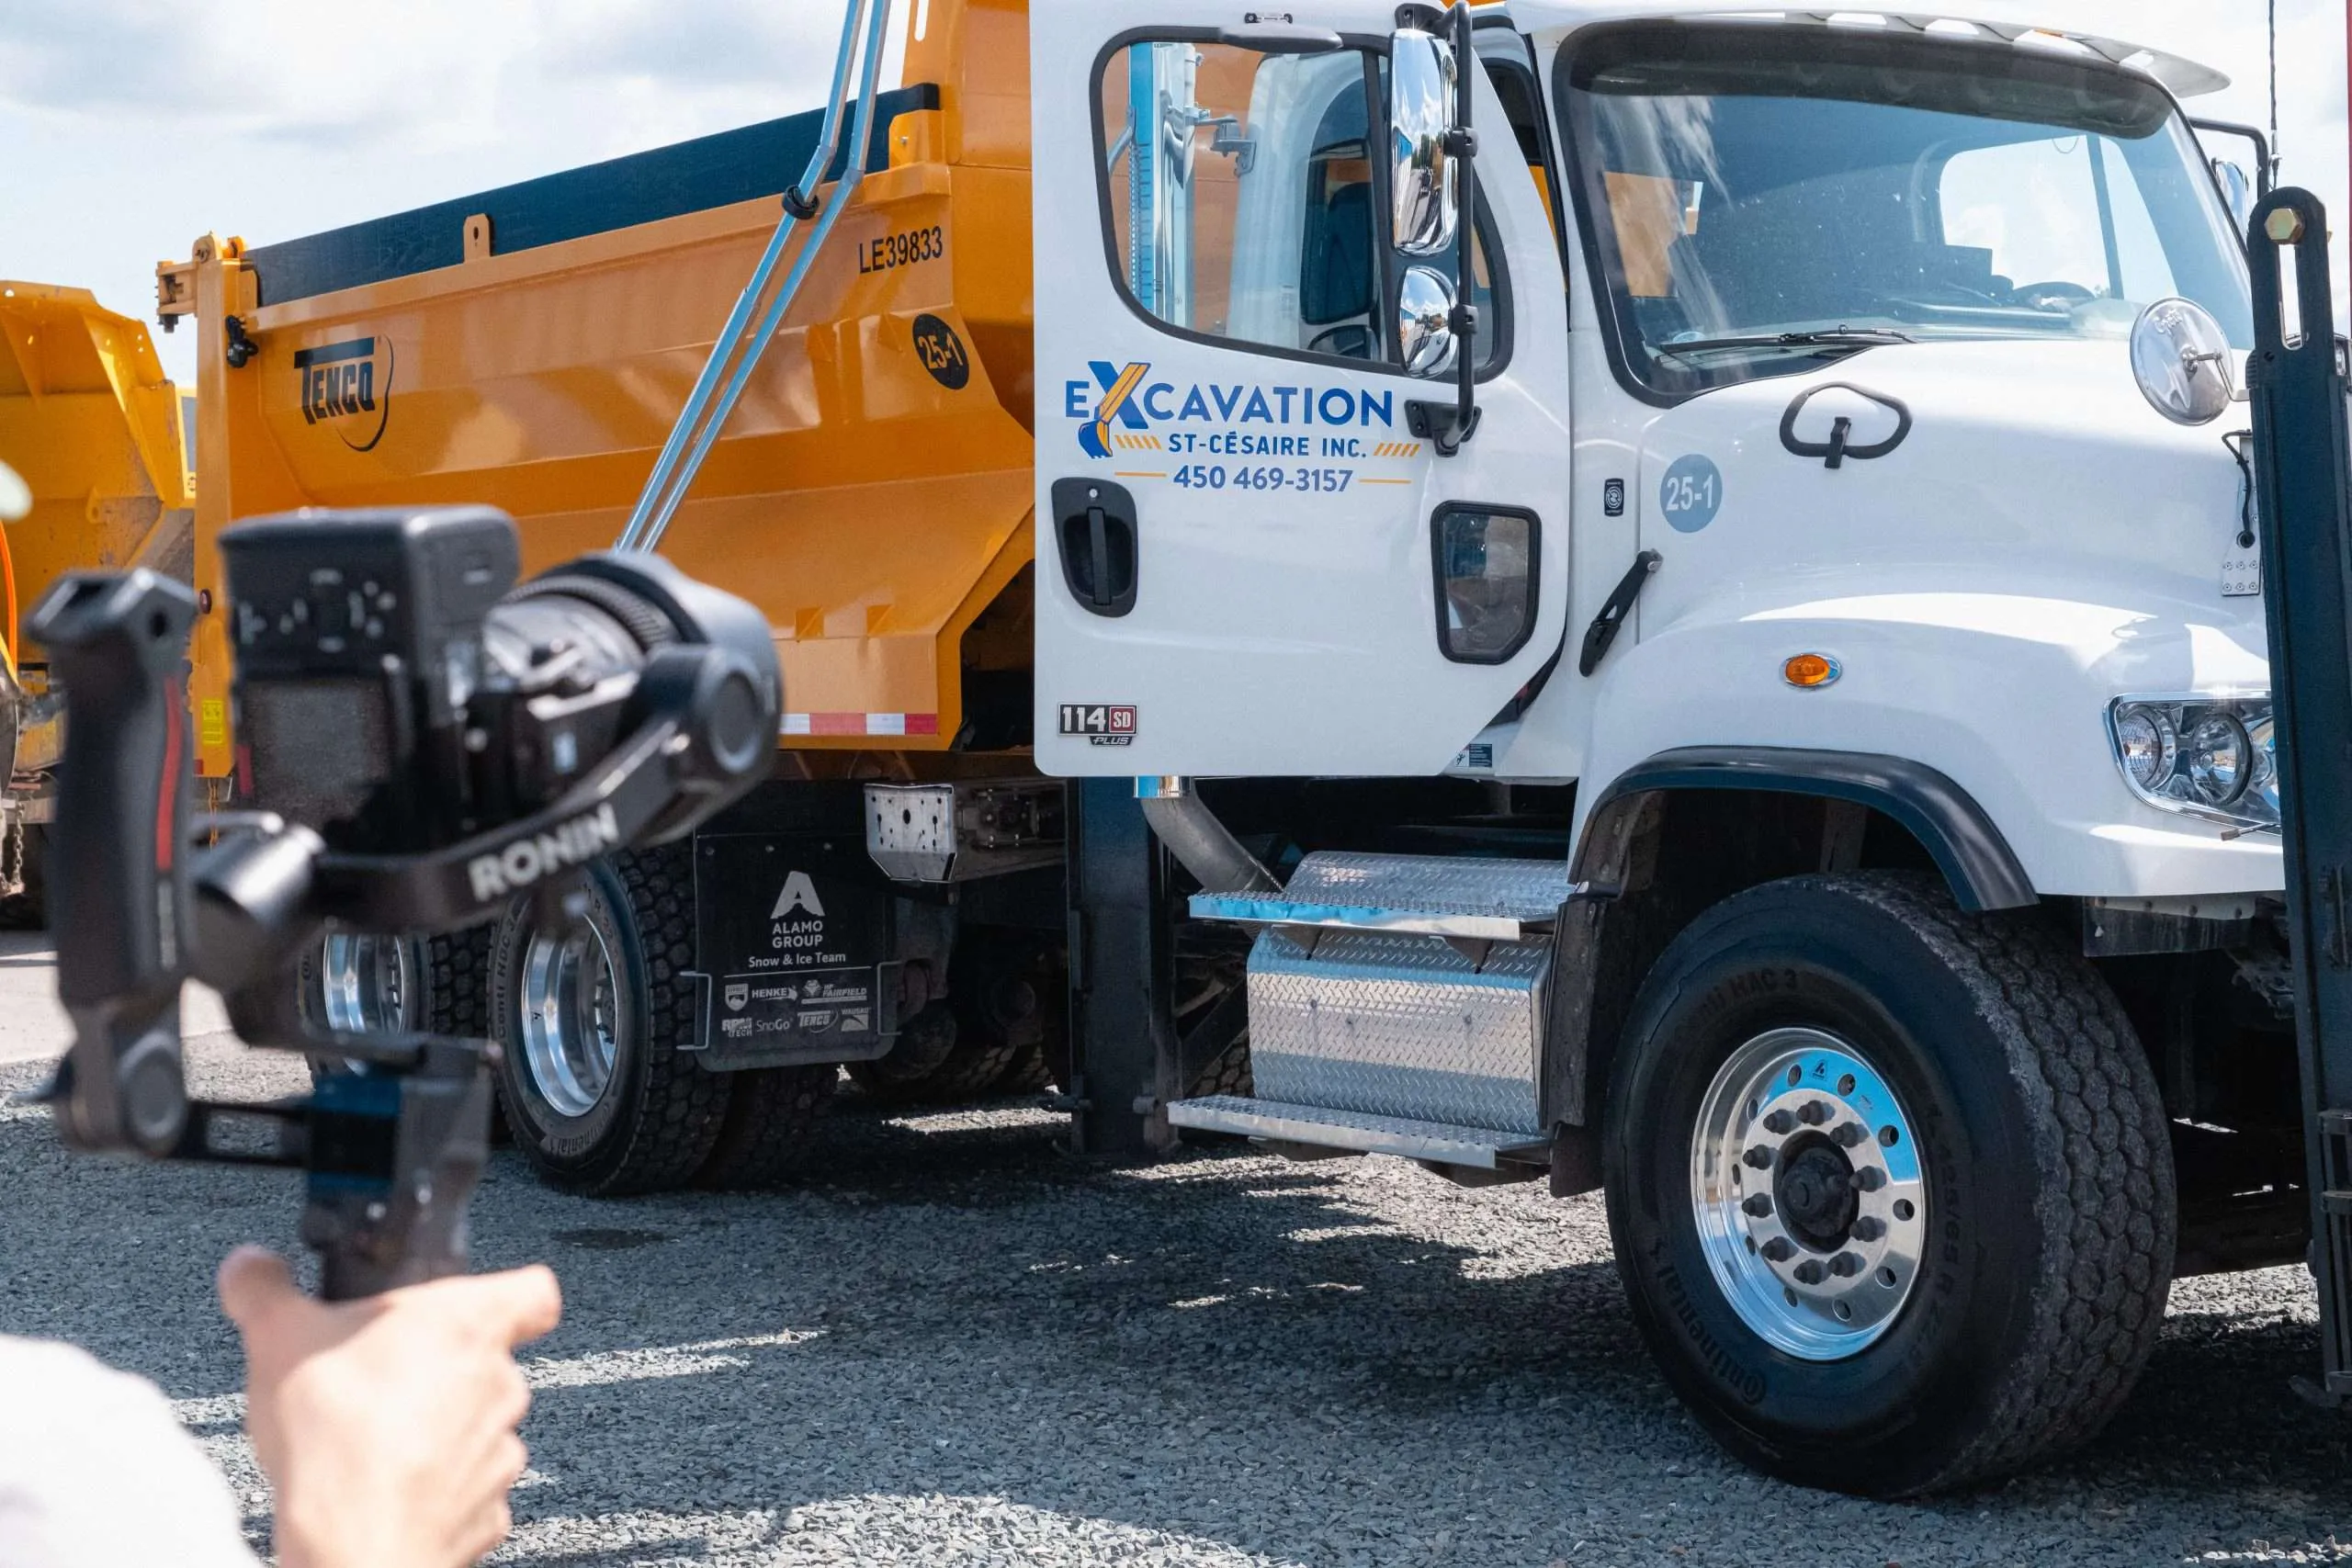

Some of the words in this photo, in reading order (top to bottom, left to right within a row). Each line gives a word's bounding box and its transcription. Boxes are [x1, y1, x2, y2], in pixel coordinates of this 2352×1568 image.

[859, 226, 943, 274] LE39833
[918, 333, 963, 369] 25-1
[294, 336, 375, 424] TENCO
[1065, 361, 1393, 429] EXCAVATION
[1168, 431, 1309, 456] ST-CÉSAIRE
[1322, 438, 1367, 457] INC.
[1172, 465, 1227, 490] 450
[1233, 467, 1353, 491] 469-3157
[1666, 474, 1713, 511] 25-1
[1062, 706, 1106, 732] 114
[1113, 711, 1131, 728] SD
[1092, 737, 1129, 745] PLUS
[468, 801, 619, 902] RONIN
[772, 920, 823, 935] ALAMO
[772, 934, 823, 948] GROUP
[749, 956, 779, 967] Snow
[783, 954, 793, 965] &
[797, 954, 812, 964] Ice
[816, 952, 846, 964] Team
[752, 987, 787, 998] HENKE
[756, 1018, 790, 1032] SnoGo
